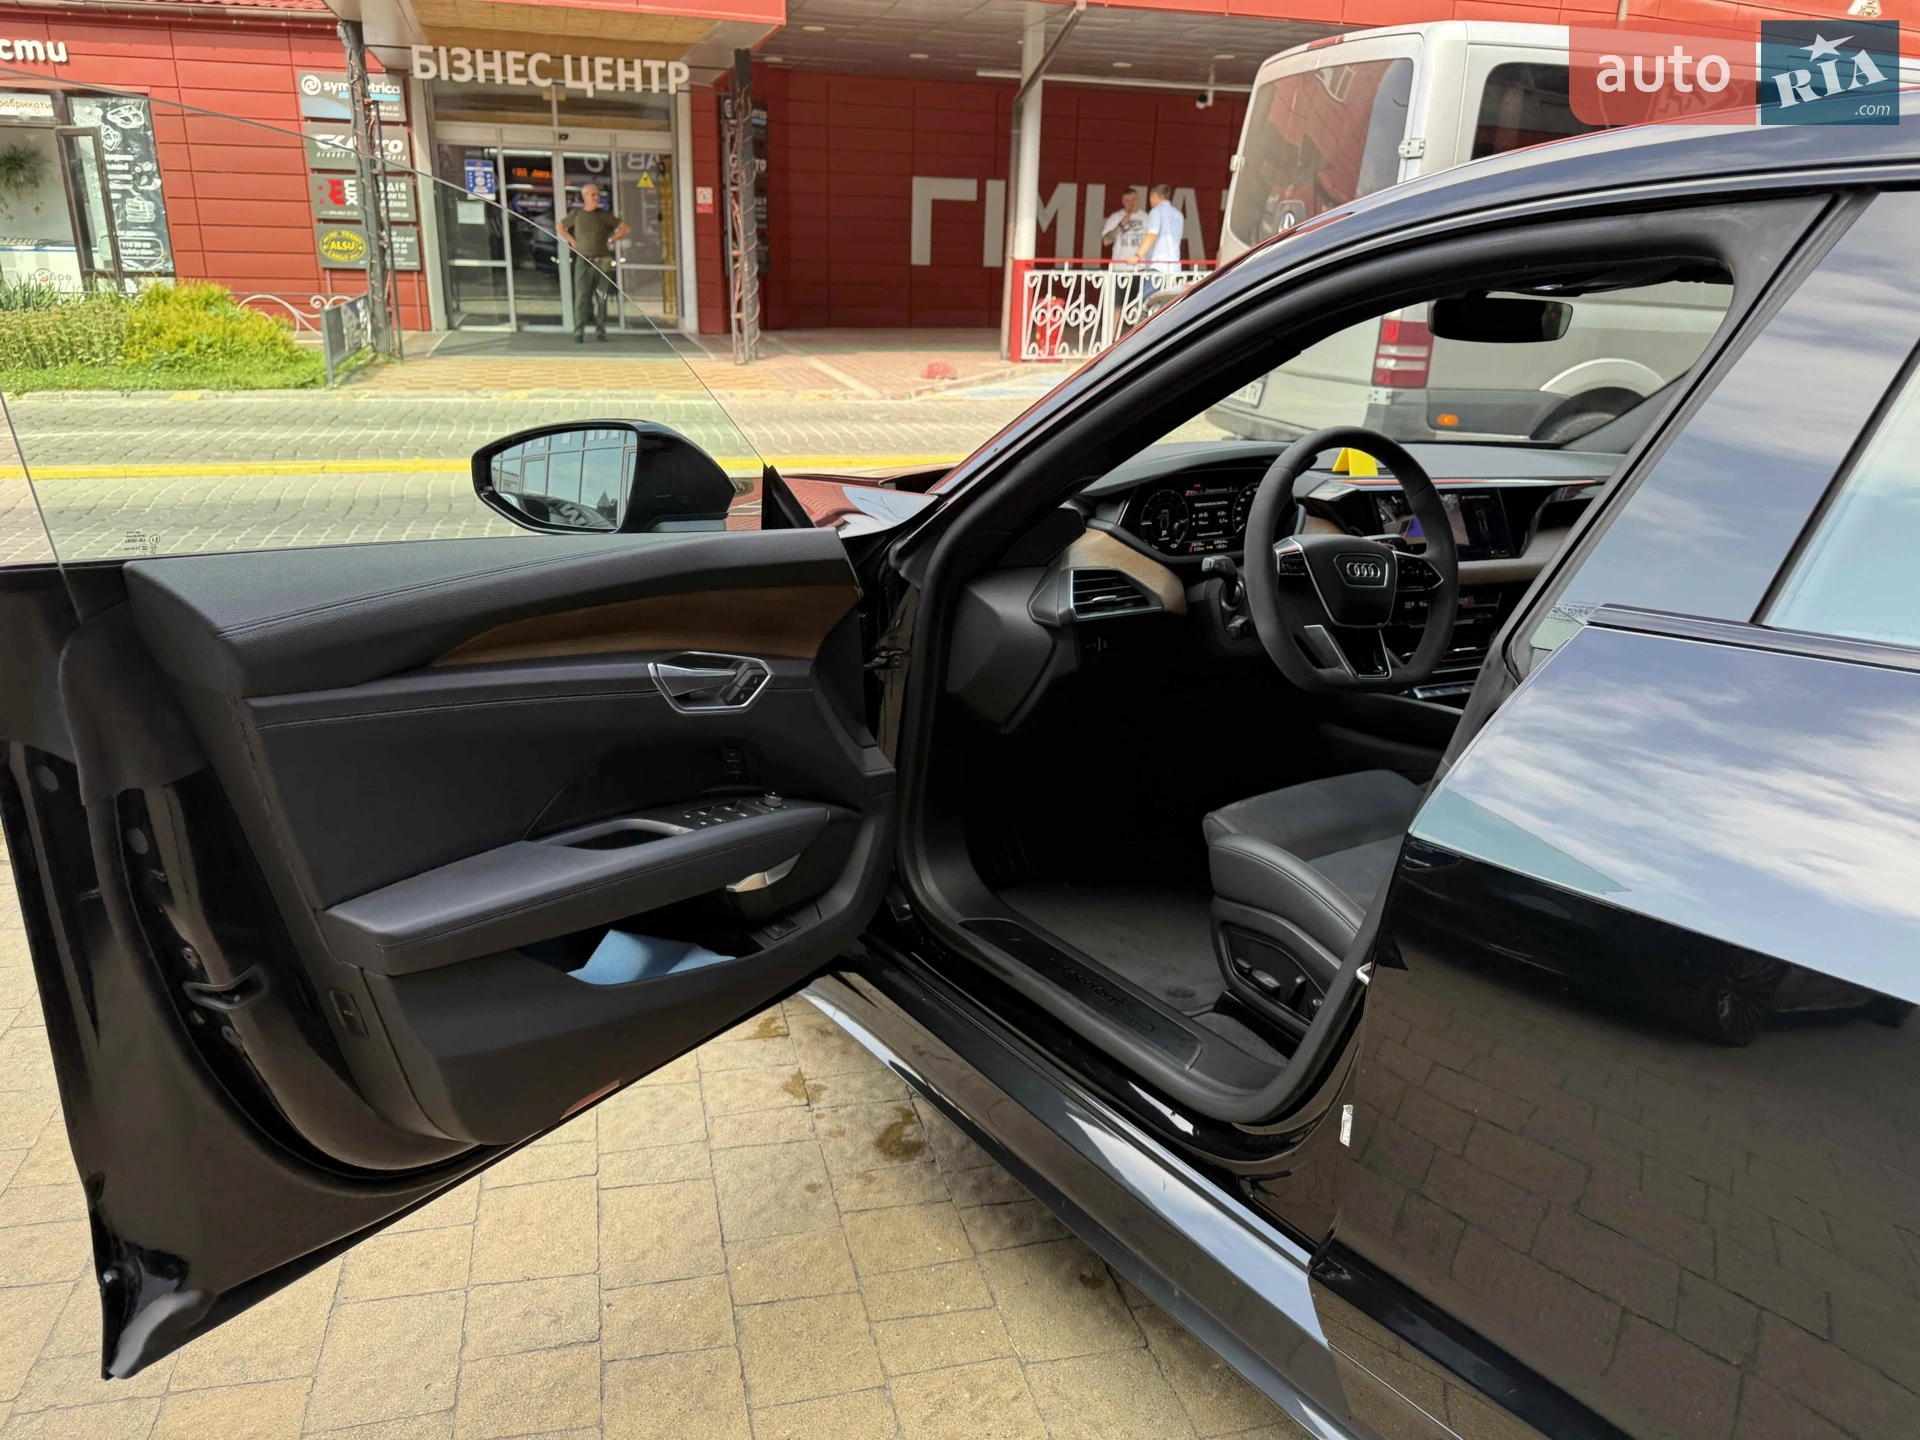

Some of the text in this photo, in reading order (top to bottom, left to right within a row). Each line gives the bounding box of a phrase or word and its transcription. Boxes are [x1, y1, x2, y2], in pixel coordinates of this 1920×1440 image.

[411, 44, 690, 98] БІЗНЕС ЦЕНТР
[330, 240, 356, 251] ALSU
